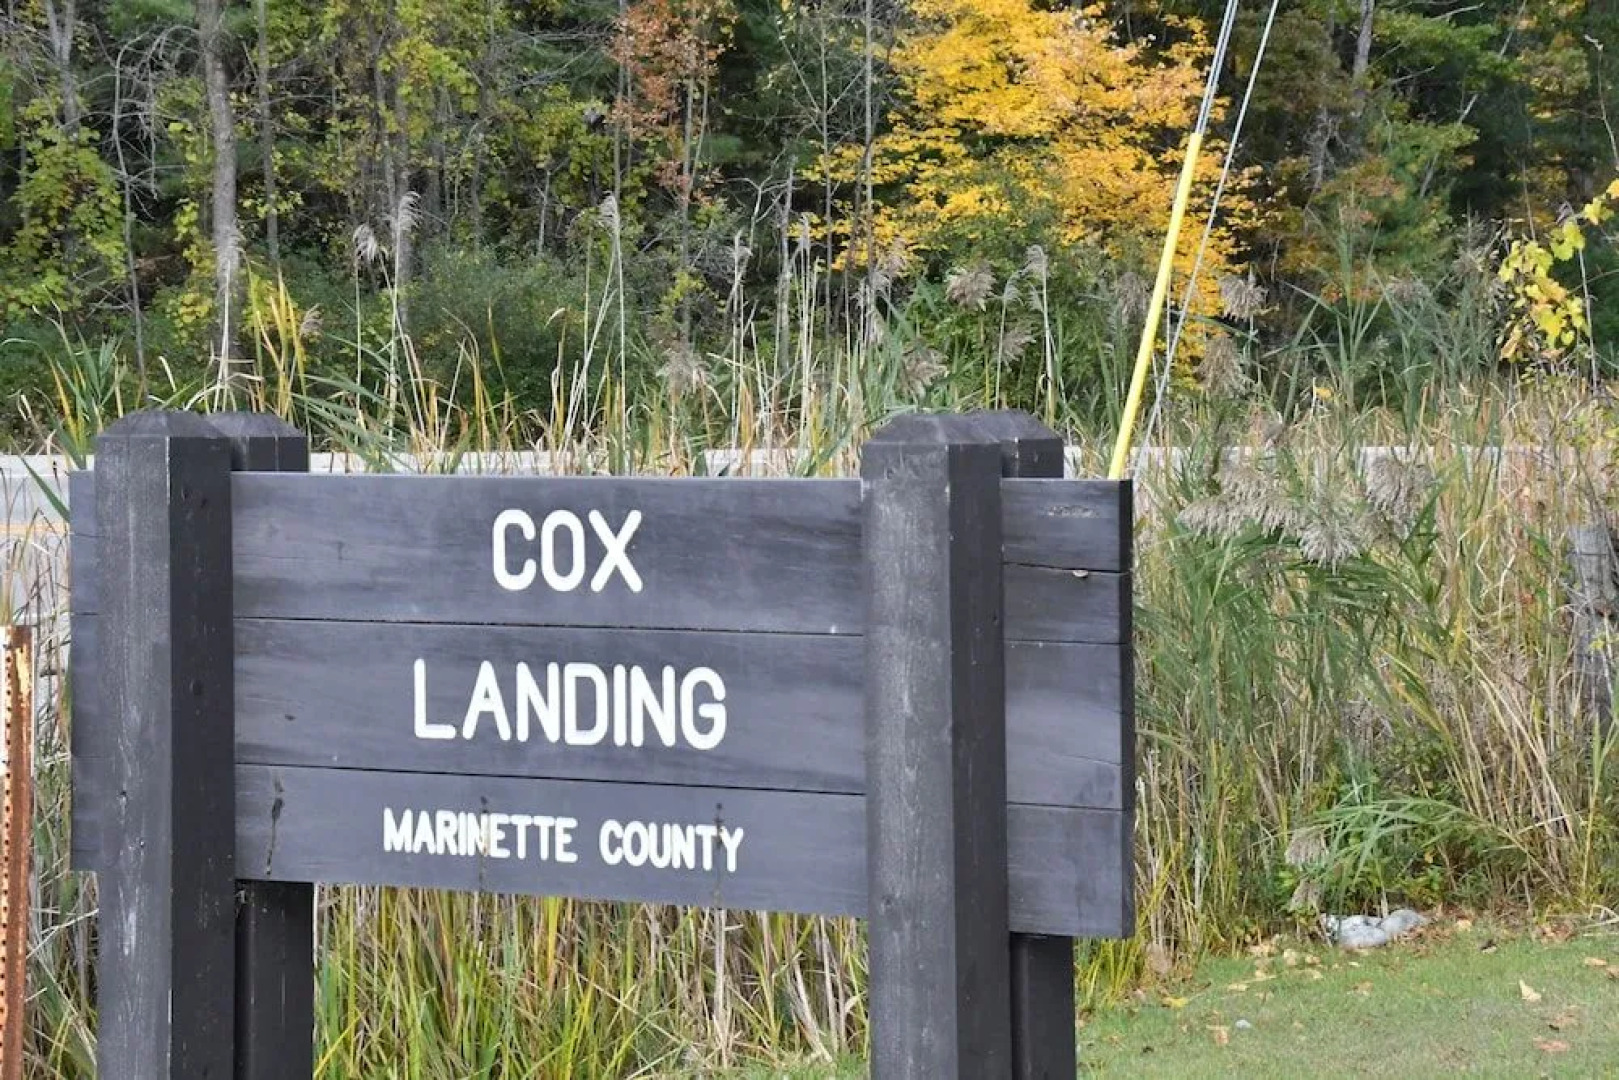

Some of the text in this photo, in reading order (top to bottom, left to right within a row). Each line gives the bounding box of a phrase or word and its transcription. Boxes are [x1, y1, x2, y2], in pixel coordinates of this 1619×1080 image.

[492, 509, 643, 593] COX
[413, 658, 728, 751] LANDING
[383, 807, 744, 872] MARINETTE COUNTY
